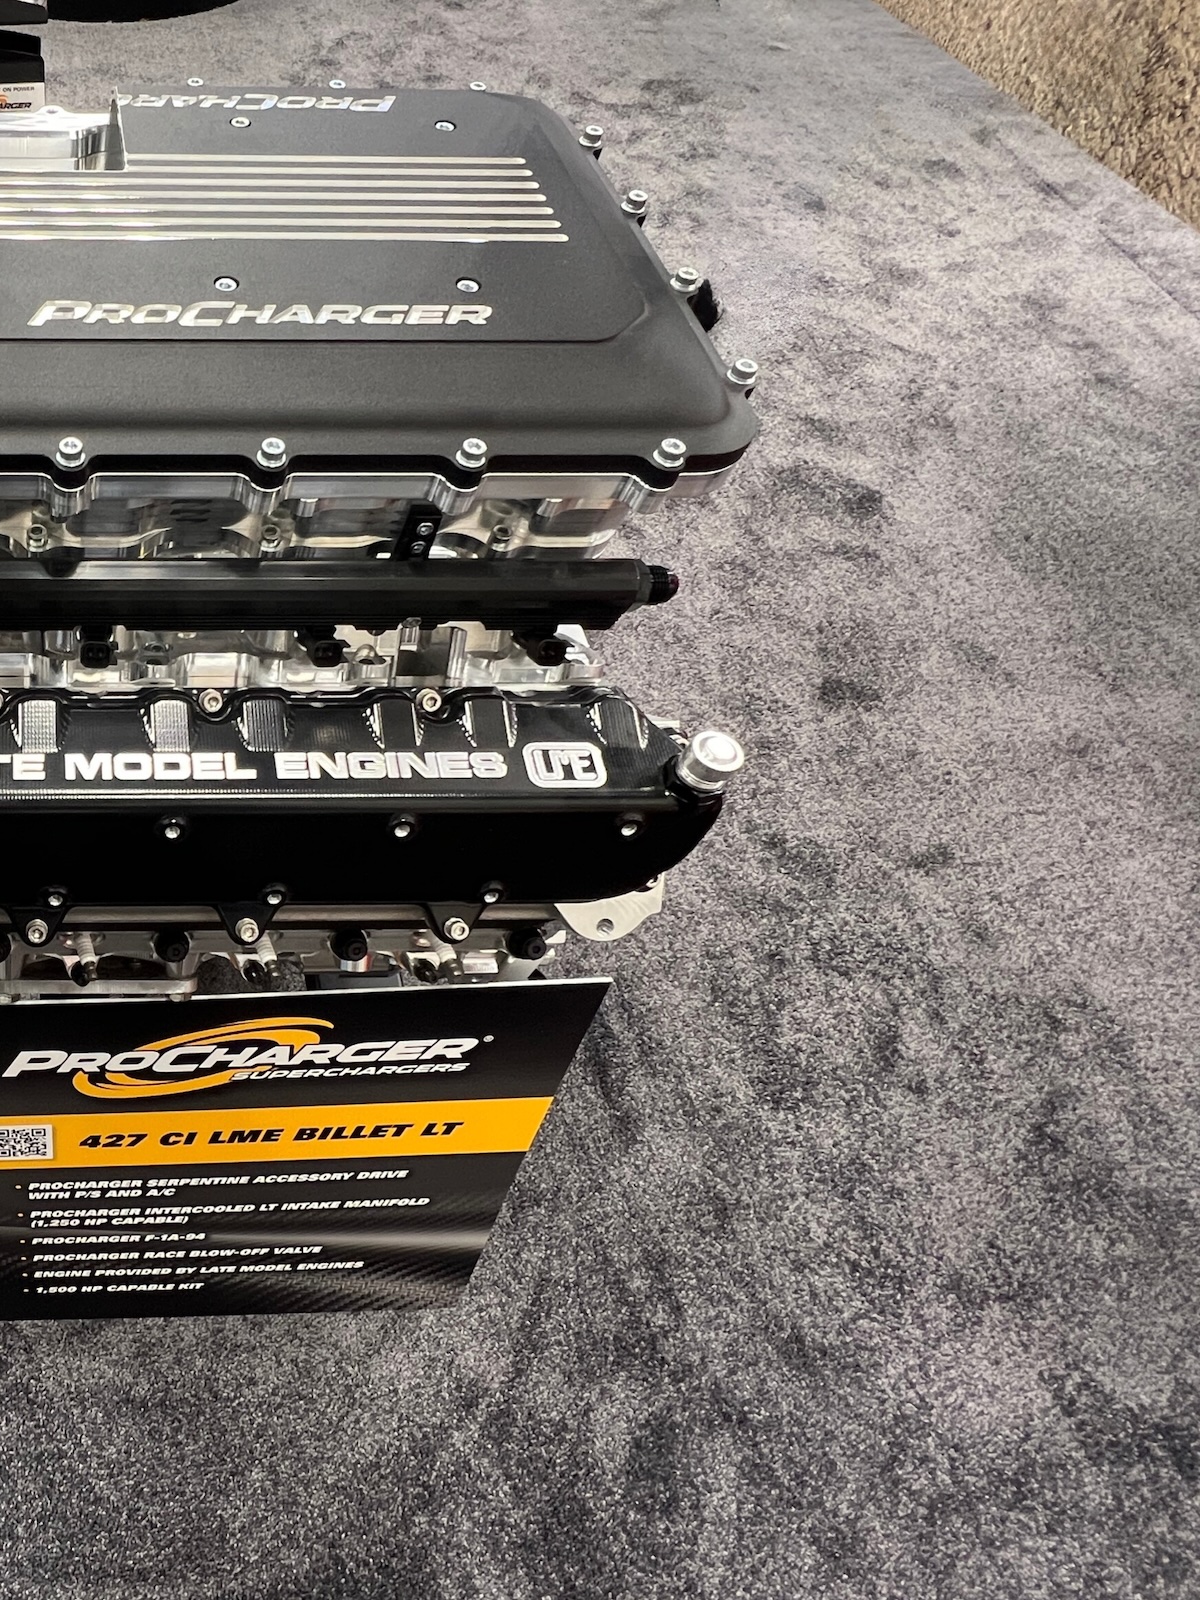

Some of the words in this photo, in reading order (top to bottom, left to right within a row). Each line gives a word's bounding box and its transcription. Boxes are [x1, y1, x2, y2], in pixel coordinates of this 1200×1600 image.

[27, 300, 493, 326] PROCHARGER
[64, 752, 257, 780] MODEL
[274, 752, 507, 779] ENGINES
[2, 1037, 480, 1078] PROCHARGER
[231, 1062, 471, 1081] SUPERCHARGERS
[79, 1133, 148, 1149] 427
[159, 1132, 197, 1146] CI
[207, 1128, 284, 1144] LME
[292, 1123, 414, 1142] BILLET
[420, 1122, 464, 1136] LT
[28, 1180, 142, 1191] PROCHARGER
[146, 1176, 250, 1188] SERPENTINE
[253, 1172, 355, 1184] ACCESSORY
[357, 1170, 409, 1180] DRIVE
[28, 1191, 70, 1200] WITH
[74, 1190, 101, 1199] P/S
[105, 1189, 142, 1197] AND
[146, 1188, 176, 1197] A/C
[30, 1208, 141, 1218] PROCHARGER
[145, 1204, 255, 1215] INTERCOOLED
[259, 1203, 278, 1212] LT
[281, 1201, 341, 1211] INTAKE
[343, 1198, 430, 1208] MANIFOLD
[31, 1219, 81, 1228] (1,250
[111, 1216, 189, 1225] CAPABLE)
[31, 1234, 141, 1245] PROCHARGER
[144, 1233, 206, 1242] F-1A-94
[33, 1252, 140, 1262] PROCHARGER
[143, 1250, 186, 1259] RACE
[189, 1248, 270, 1258] BLOW-OFF
[274, 1246, 323, 1255] VALVE
[34, 1270, 91, 1278] ENGINE
[94, 1268, 172, 1277] PROVIDED
[175, 1267, 197, 1275] BY
[200, 1265, 237, 1274] LATE
[239, 1263, 292, 1273] MODEL
[297, 1261, 364, 1271] ENGINES
[36, 1286, 77, 1294] 1,500
[107, 1283, 175, 1292] CAPABLE
[178, 1282, 204, 1290] KIT
